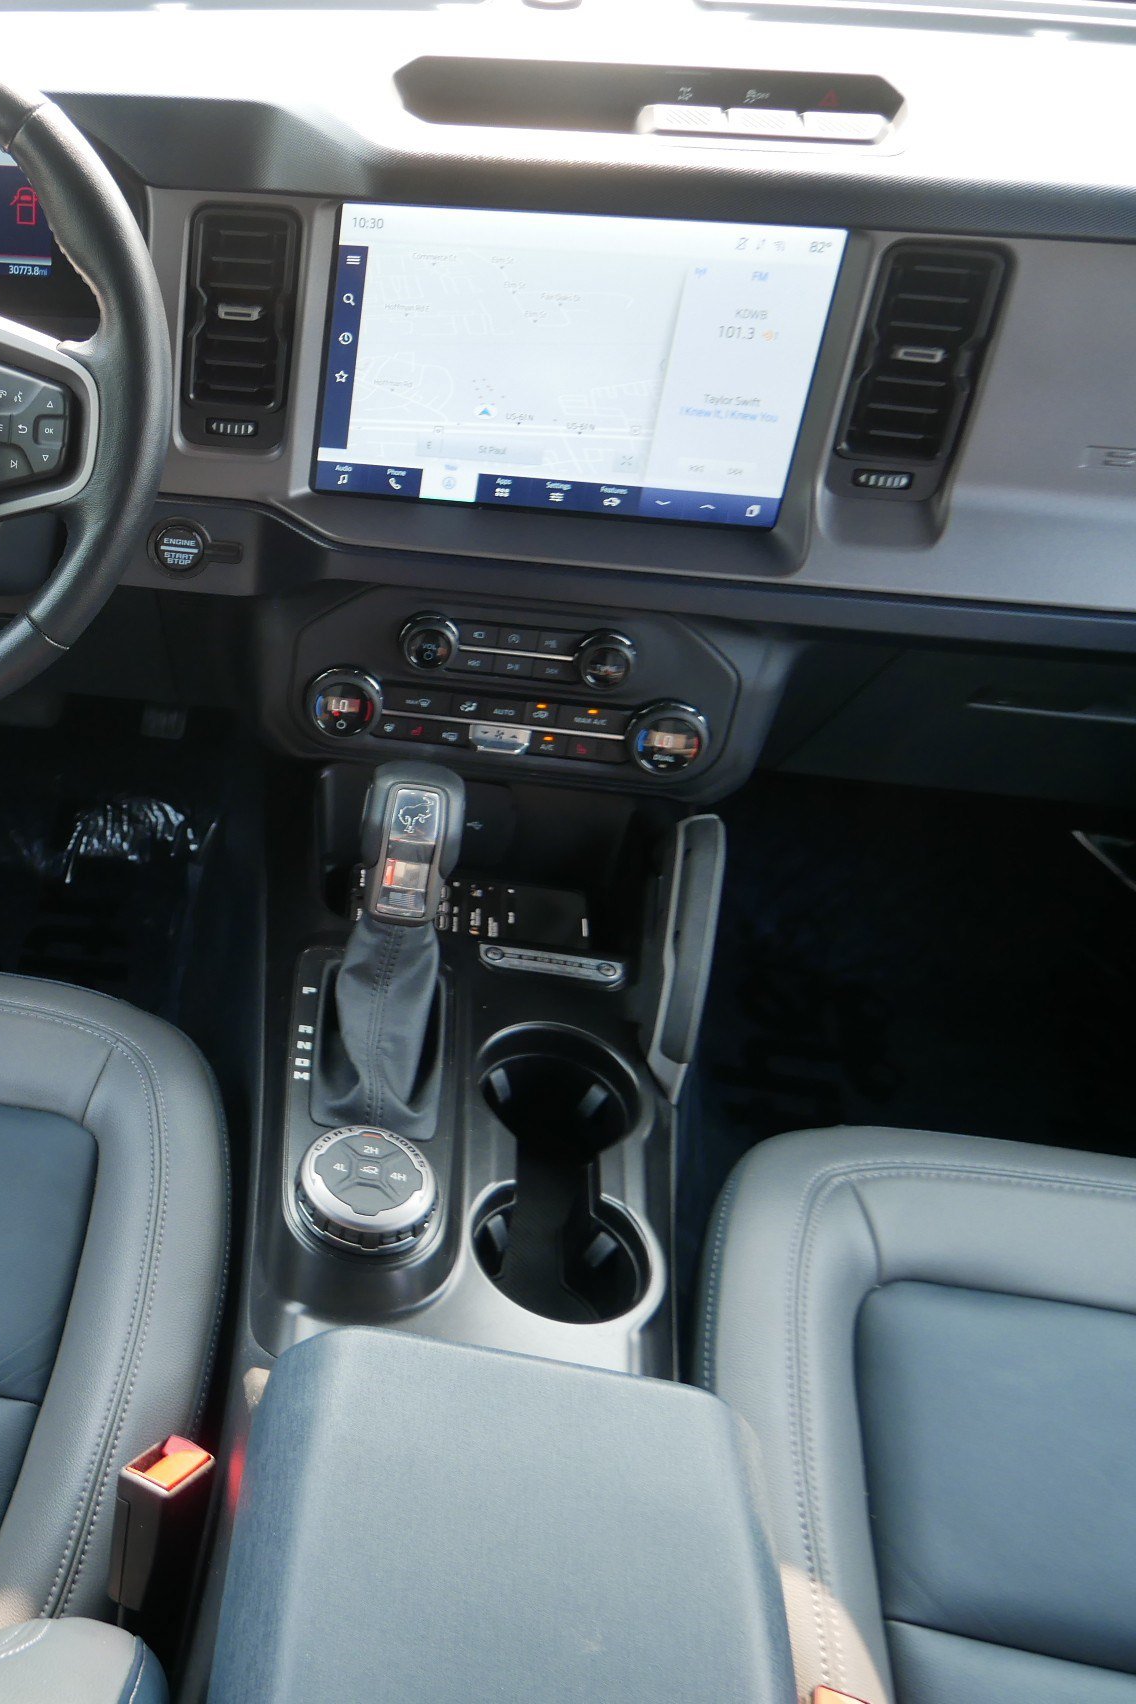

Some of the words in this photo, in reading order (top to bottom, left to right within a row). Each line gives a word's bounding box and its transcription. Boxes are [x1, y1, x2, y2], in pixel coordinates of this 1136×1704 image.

[351, 217, 384, 229] 10:30
[752, 271, 769, 282] FM
[735, 308, 768, 320] KDWB
[717, 325, 755, 340] 101.3
[704, 394, 733, 406] Taylor
[736, 396, 762, 407] Swift
[685, 407, 712, 418] Knew
[730, 410, 758, 421] Knew
[478, 445, 487, 454] St
[489, 446, 507, 455] Paul
[334, 464, 353, 472] Audio
[386, 468, 407, 477] Phone
[495, 477, 512, 486] Apps
[545, 481, 572, 491] Settings
[599, 486, 628, 495] Features
[163, 538, 196, 547] ENGINE
[164, 552, 194, 560] START
[332, 699, 348, 713] LO
[493, 708, 515, 716] AUTO
[593, 718, 607, 726] A/C
[302, 986, 317, 995] P
[298, 1024, 313, 1034] R
[296, 1040, 312, 1050] N
[295, 1057, 311, 1067] D
[293, 1070, 310, 1081] M
[363, 1145, 379, 1155] 2H
[388, 1133, 427, 1168] MODES
[333, 1162, 347, 1172] 4L
[390, 1172, 407, 1182] 4H
